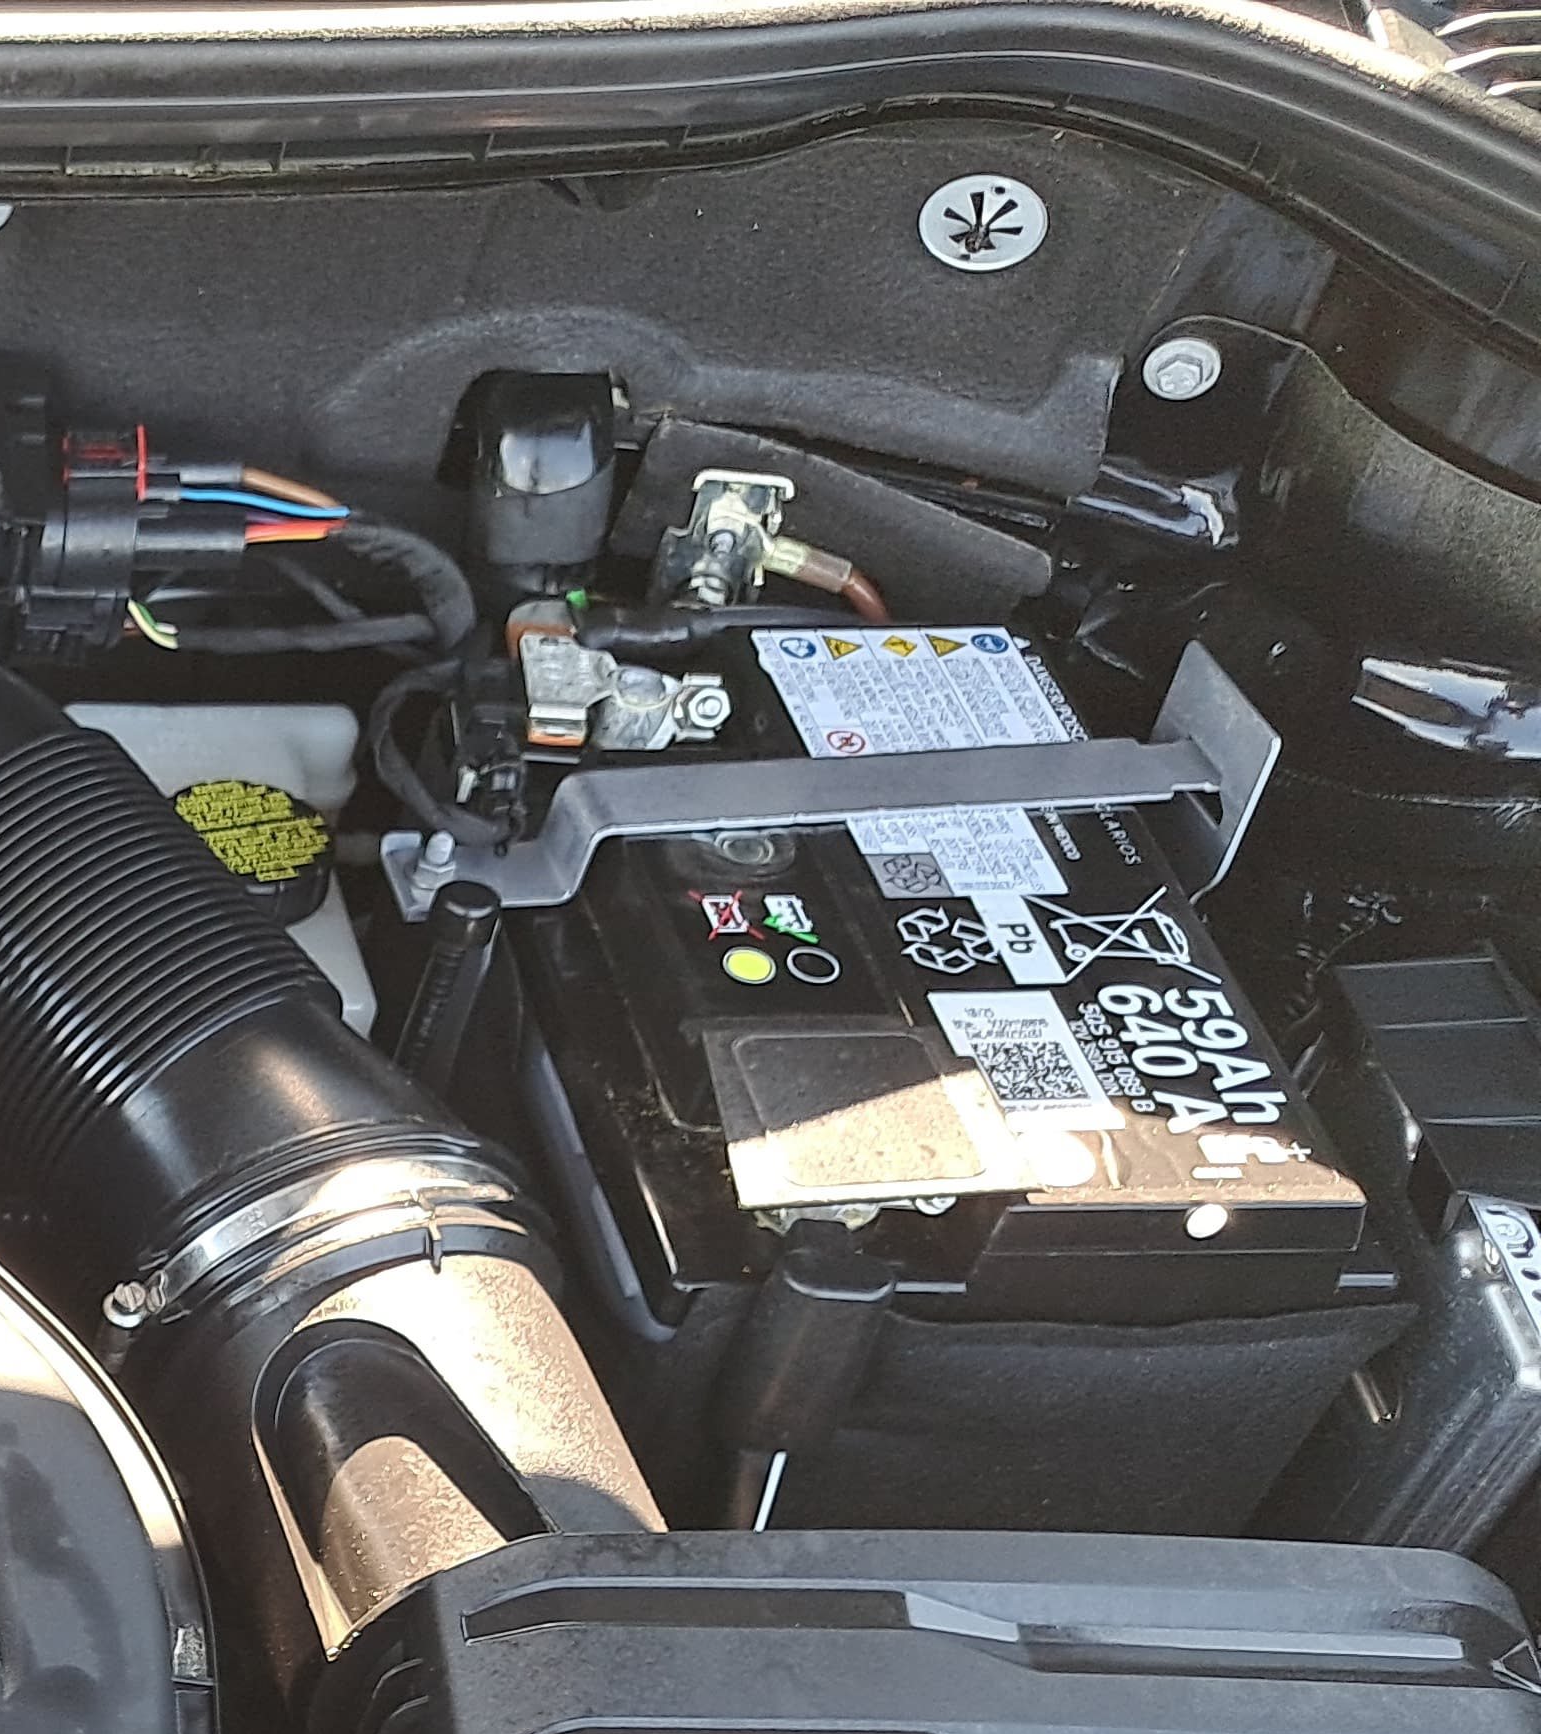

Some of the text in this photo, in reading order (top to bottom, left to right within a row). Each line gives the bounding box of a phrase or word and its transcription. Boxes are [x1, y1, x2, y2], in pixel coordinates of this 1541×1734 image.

[1093, 802, 1142, 865] CLARIOS
[997, 922, 1037, 954] Pb
[1097, 984, 1230, 1134] 640 A
[1098, 1037, 1130, 1065] 915
[1165, 988, 1288, 1124] 59Ah
